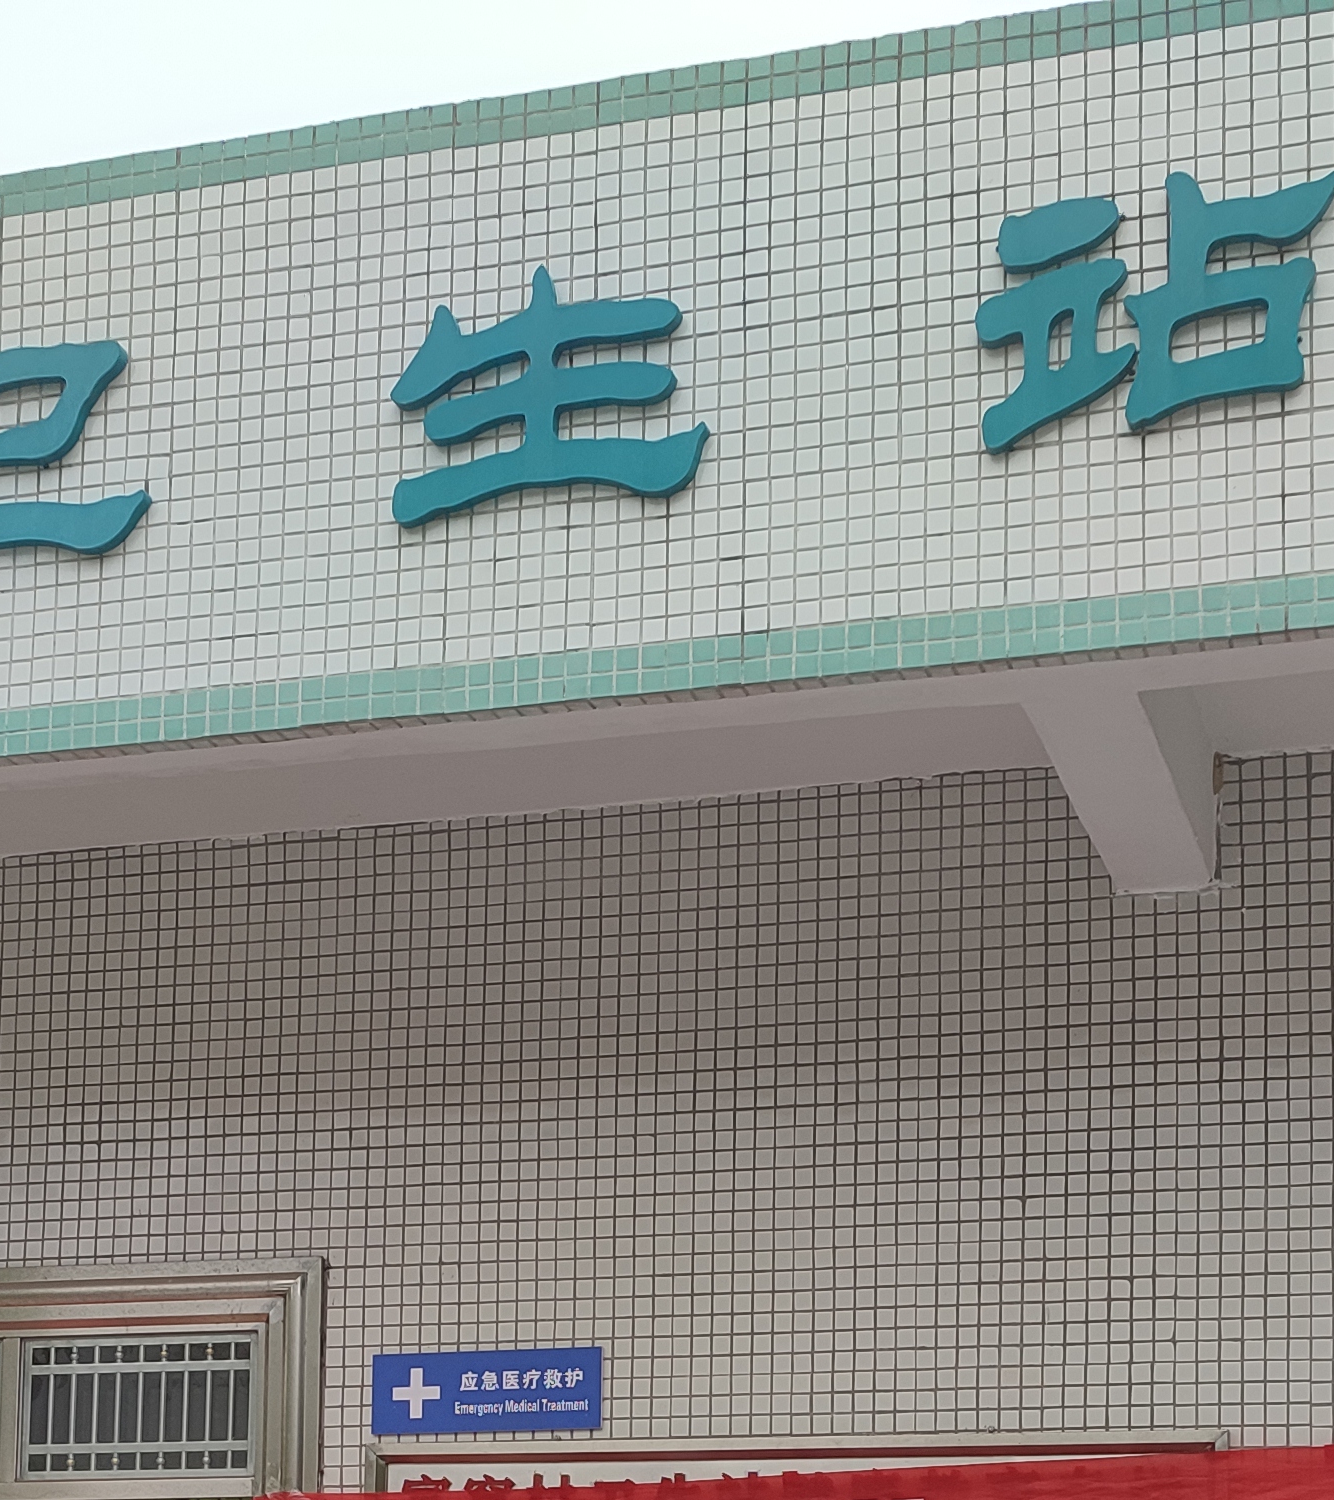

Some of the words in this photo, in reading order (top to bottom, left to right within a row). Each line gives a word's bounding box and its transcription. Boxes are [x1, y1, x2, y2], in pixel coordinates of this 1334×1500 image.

[459, 1368, 584, 1392] 应急医疗救护
[454, 1401, 503, 1416] Emergency
[505, 1400, 540, 1413] Medical
[541, 1398, 589, 1412] Treatment
